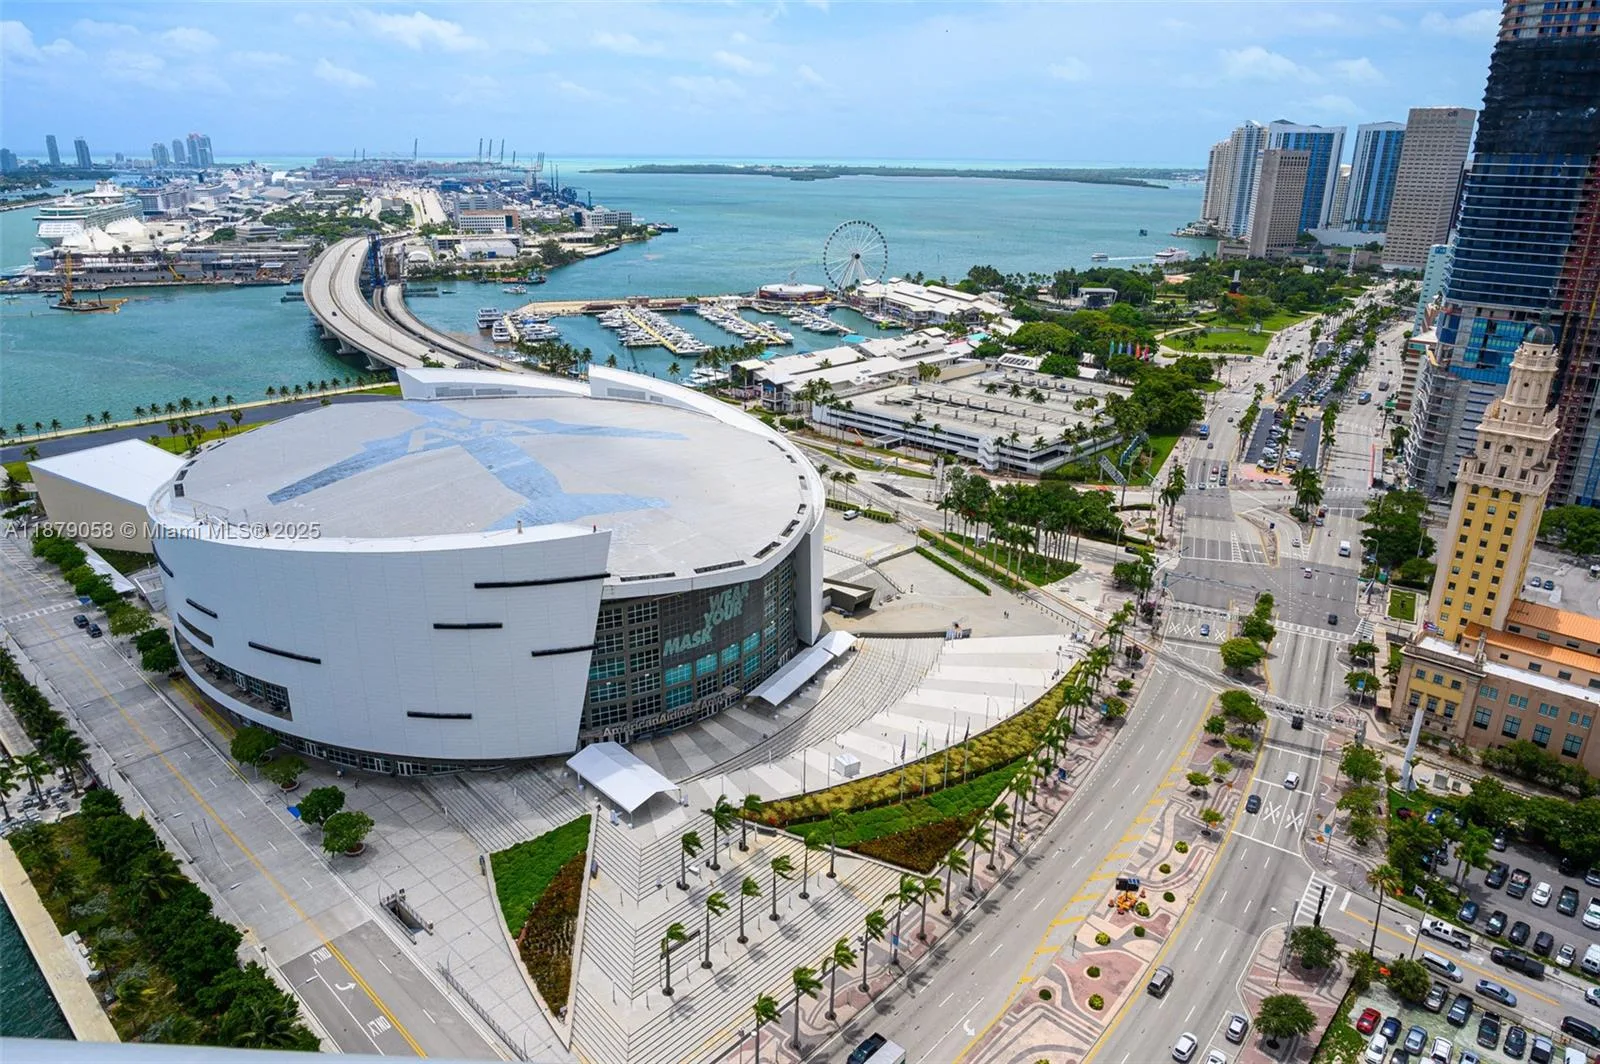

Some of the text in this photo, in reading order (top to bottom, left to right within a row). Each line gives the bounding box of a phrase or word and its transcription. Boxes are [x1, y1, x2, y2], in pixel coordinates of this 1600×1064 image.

[709, 582, 749, 609] WEAR
[704, 600, 743, 627] YOUR
[663, 626, 713, 656] MASK
[309, 946, 332, 965] ONLY
[367, 1015, 391, 1038] ONLY
